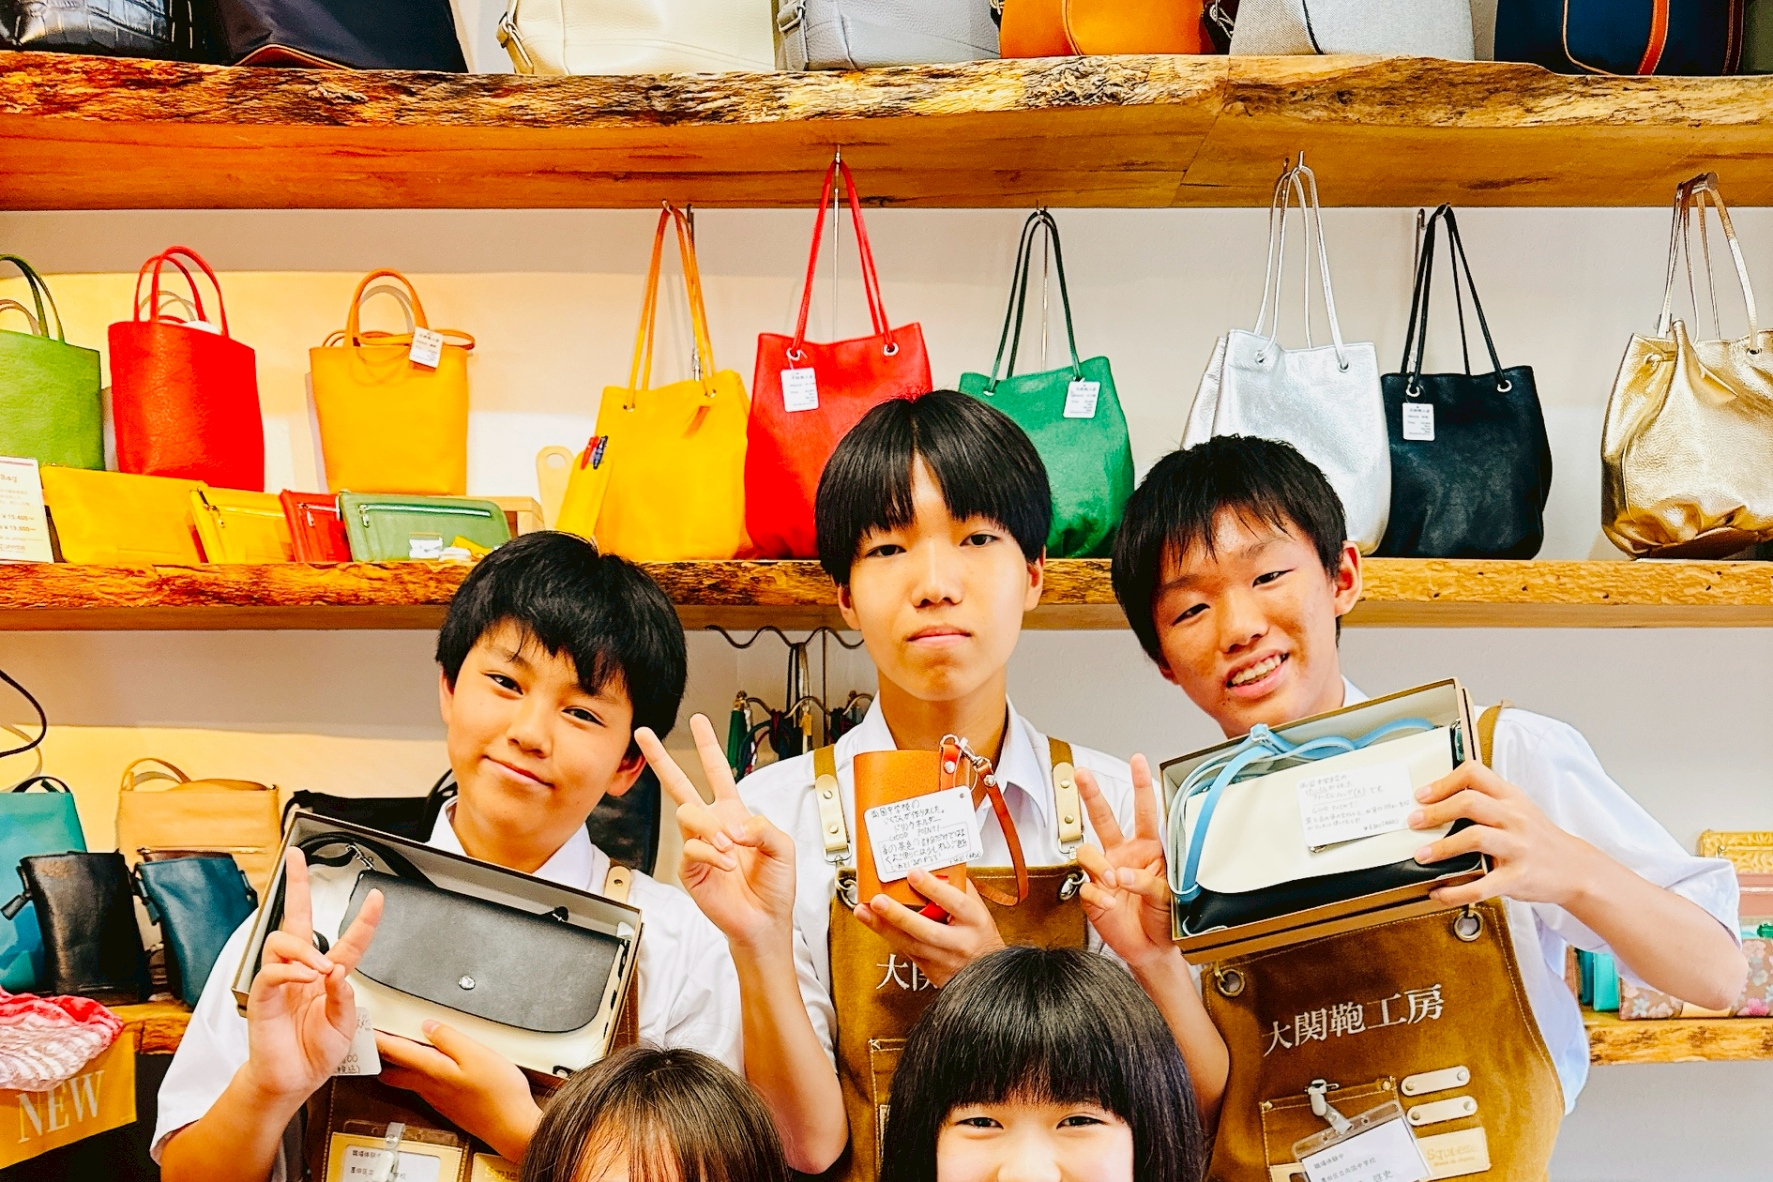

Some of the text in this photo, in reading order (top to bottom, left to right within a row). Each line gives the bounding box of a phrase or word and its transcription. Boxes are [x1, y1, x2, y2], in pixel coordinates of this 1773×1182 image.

[1261, 983, 1445, 1058] 大関鞄工房
[15, 1069, 105, 1144] NEW
